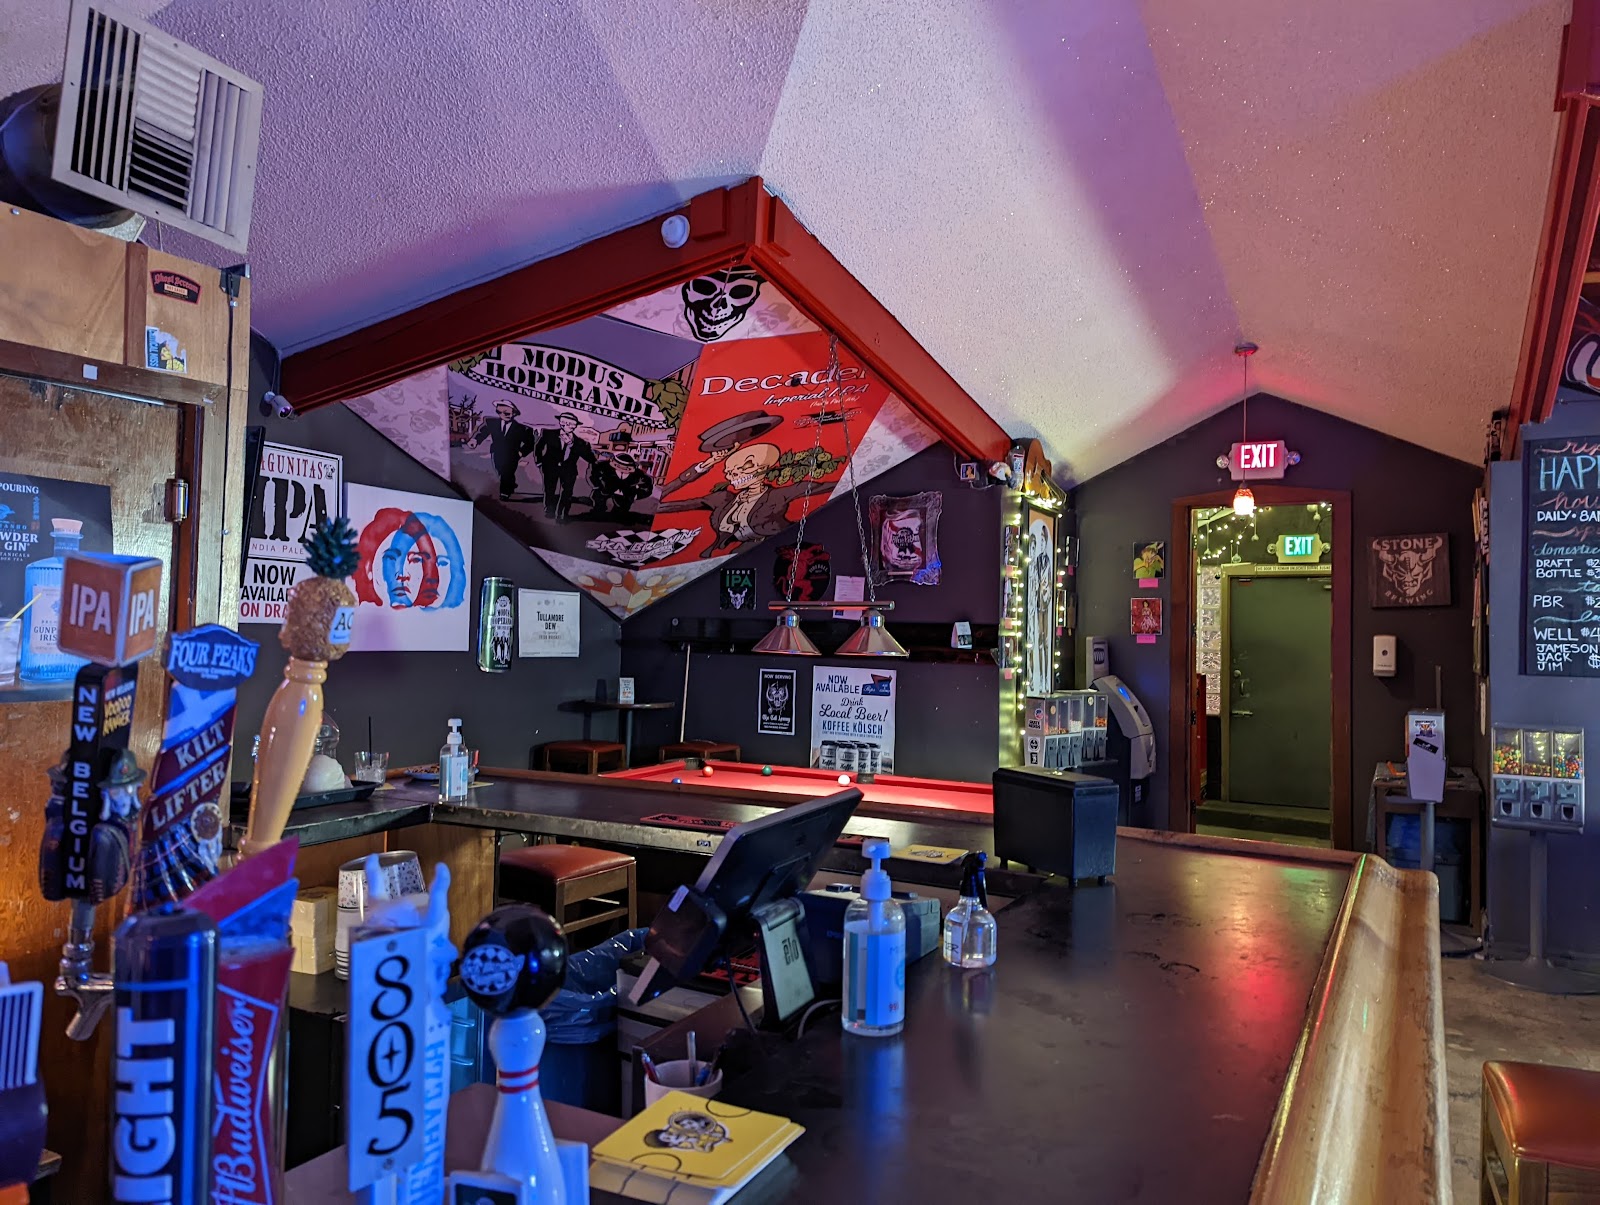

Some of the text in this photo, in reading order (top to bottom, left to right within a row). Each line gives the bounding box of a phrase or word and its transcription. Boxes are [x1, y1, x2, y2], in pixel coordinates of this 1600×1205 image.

[522, 348, 624, 390] MODUS
[486, 361, 655, 418] HOPERANDI
[763, 387, 829, 407] Imperial
[517, 386, 619, 419] INDIA PALE ALE
[1240, 443, 1278, 469] EXIT
[251, 475, 328, 544] IPA
[1537, 510, 1571, 521] DAILY
[252, 543, 276, 552] NDIA
[586, 526, 702, 552] SKA BREWING
[1284, 536, 1314, 556] EXIT
[1382, 538, 1433, 551] STONE
[1536, 559, 1573, 568] DRAFT
[254, 564, 296, 586] NOW
[726, 575, 752, 588] IPA
[1536, 568, 1582, 578] BOTTLE
[241, 586, 289, 602] AVAILA
[1533, 594, 1564, 608] PBR
[69, 583, 112, 636] IPA
[129, 589, 155, 637] IPA
[241, 602, 259, 617] ON
[537, 611, 564, 622] TULLAMORE
[544, 622, 556, 630] DEW
[1533, 627, 1579, 641] WELL
[1536, 643, 1598, 654] JAMESON
[1537, 652, 1572, 662] JACK
[168, 641, 258, 678] FOUR PEAKS
[1537, 661, 1563, 672] JIM
[828, 674, 848, 684] NOW
[815, 683, 860, 694] AVAILABLE
[840, 697, 864, 707] Drink
[819, 703, 889, 722] Local Beer!
[822, 720, 850, 733] KOFFEE
[853, 721, 883, 735] KÖLSCH
[174, 719, 226, 770] KILT
[66, 686, 97, 890] NEW BELGIUM
[150, 760, 227, 831] LIFTER
[366, 954, 415, 1156] 805
[114, 1005, 176, 1205] IGHT
[212, 997, 258, 1205] Budweiser
